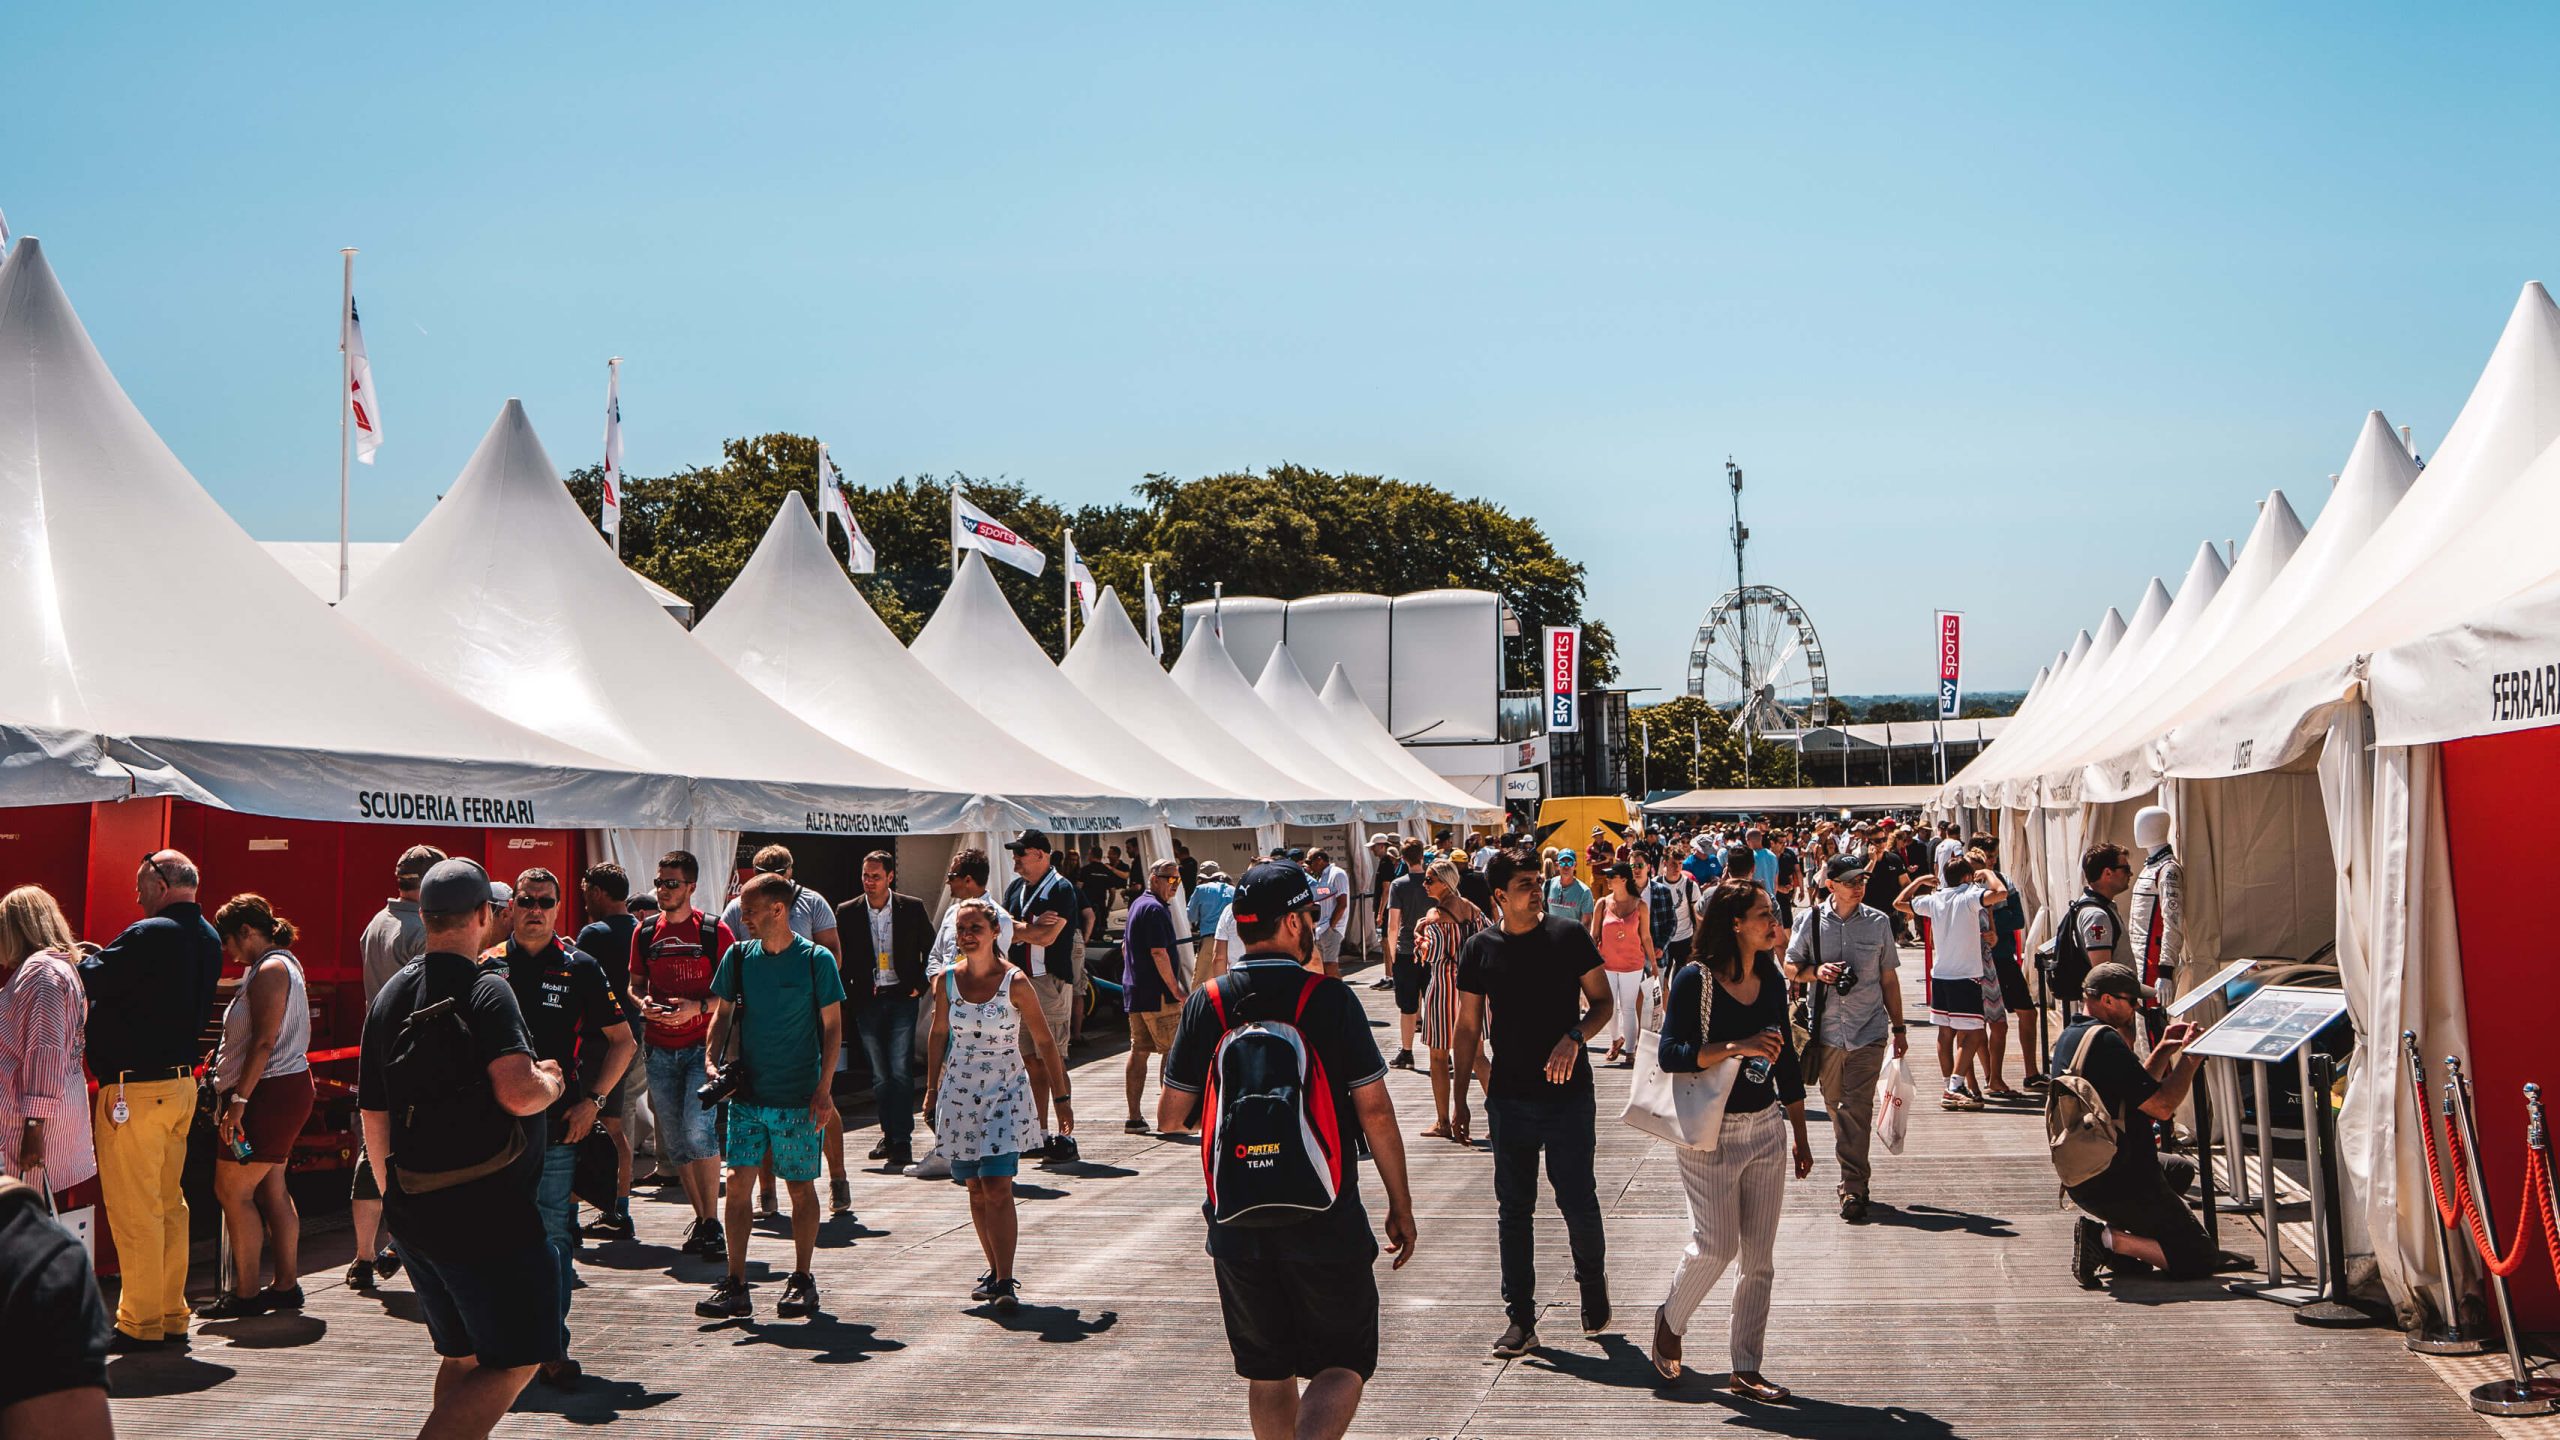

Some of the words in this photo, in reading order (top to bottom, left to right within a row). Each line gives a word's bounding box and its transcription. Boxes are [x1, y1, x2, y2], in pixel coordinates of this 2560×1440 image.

[980, 525, 1015, 542] sports
[1944, 619, 1957, 675] sports
[1556, 635, 1571, 690] sports
[1941, 681, 1955, 709] sky
[1554, 695, 1570, 723] sky
[1508, 780, 1526, 791] sky
[359, 790, 458, 821] SCUDERIA
[462, 797, 535, 824] FERRARI
[806, 812, 833, 831] ALFA
[834, 813, 870, 832] ROMEO
[871, 815, 909, 833] RACING
[541, 982, 562, 992] Mobil
[1247, 1143, 1280, 1154] PIRTEK
[1247, 1159, 1274, 1168] TEAM
